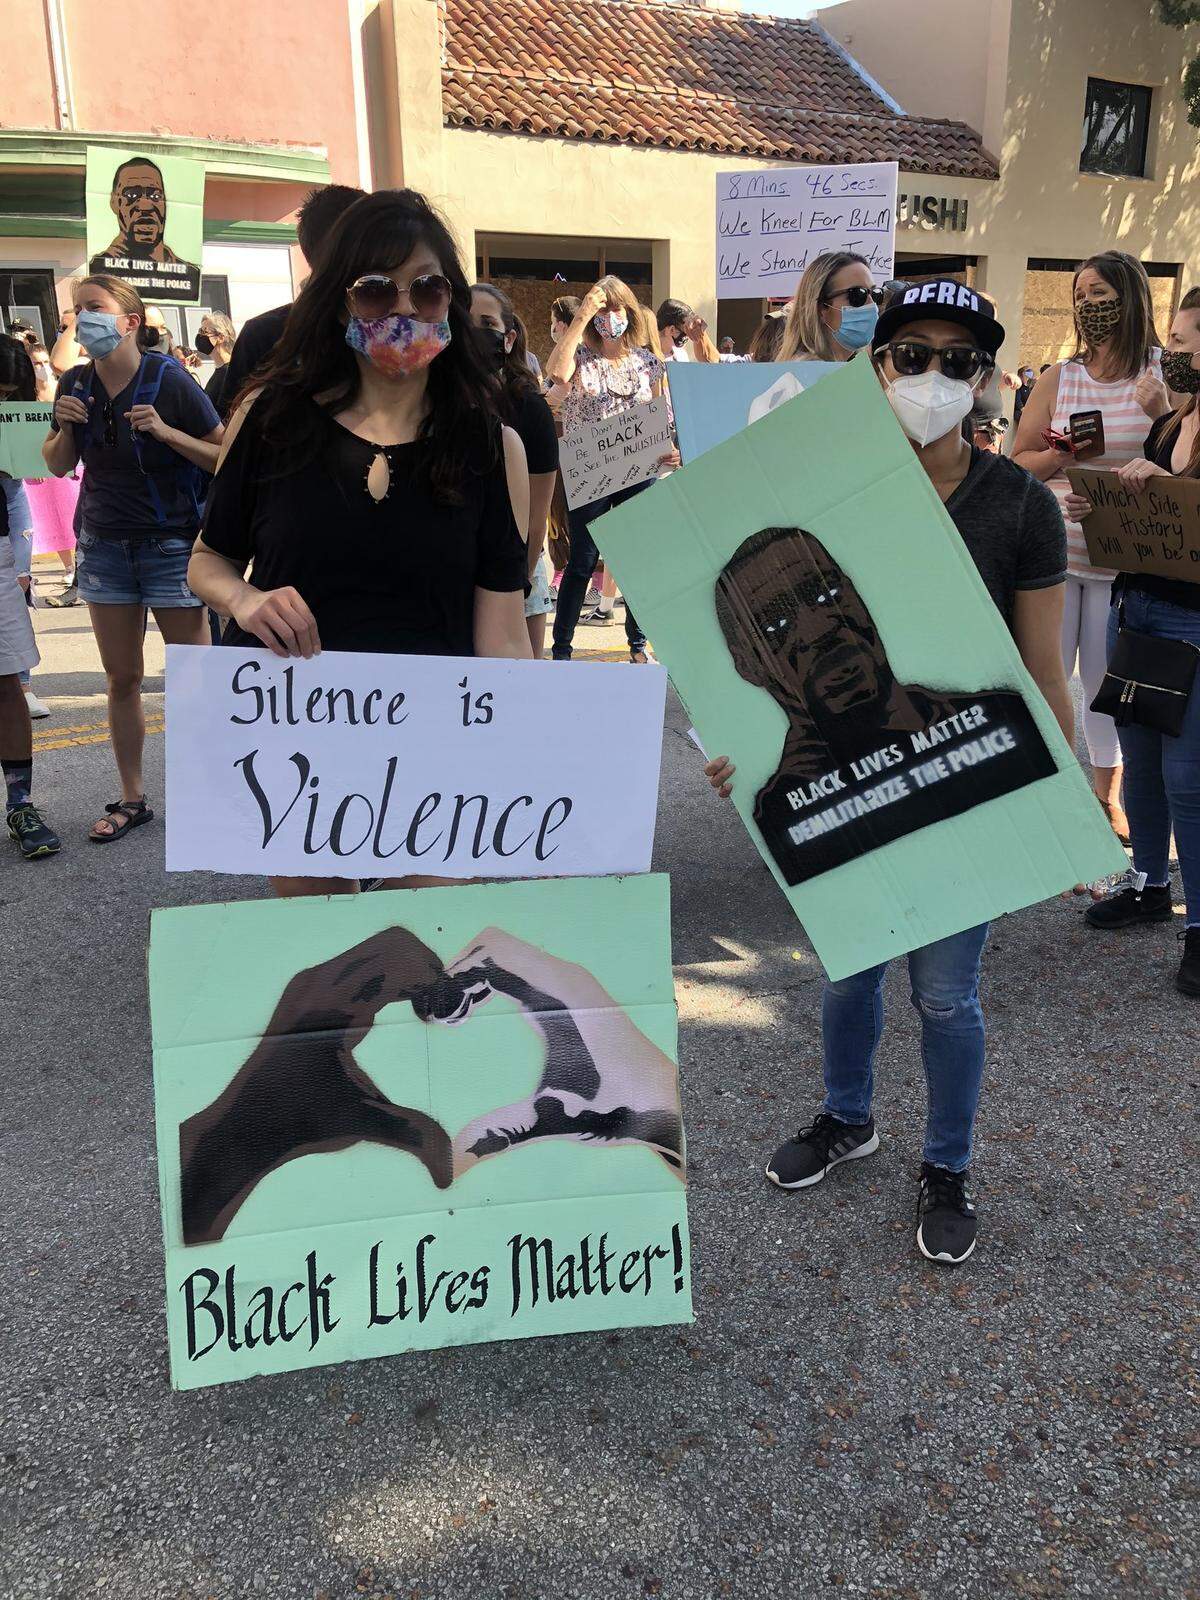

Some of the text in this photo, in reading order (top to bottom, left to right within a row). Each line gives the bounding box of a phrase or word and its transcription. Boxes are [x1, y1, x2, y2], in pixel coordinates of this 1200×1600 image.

[729, 175, 739, 199] 8
[806, 174, 831, 199] 46
[719, 211, 752, 235] We
[761, 207, 802, 230] Kneel
[810, 212, 843, 230] For
[897, 194, 969, 231] USHI
[104, 257, 187, 275] BLACK LIVES MATTER
[719, 255, 751, 277] We
[761, 250, 809, 272] Stand
[152, 279, 165, 289] THE
[166, 280, 192, 290] POLICE
[0, 412, 53, 423] AN'T BREAT
[597, 421, 644, 452] BLACK
[623, 425, 671, 457] INJUSTICE!
[1081, 477, 1139, 512] Which
[1148, 492, 1182, 518] Side
[1119, 512, 1184, 551] History
[1098, 536, 1123, 555] Will
[1133, 541, 1154, 563] you
[1162, 541, 1183, 561] be
[230, 660, 494, 728] Silence is
[786, 704, 989, 811] BLACK LIVES MATTER
[787, 726, 1017, 846] DEMILITARIZE THE POLICE
[233, 749, 573, 863] Violence
[179, 1222, 683, 1362] Black Lives Matter!
